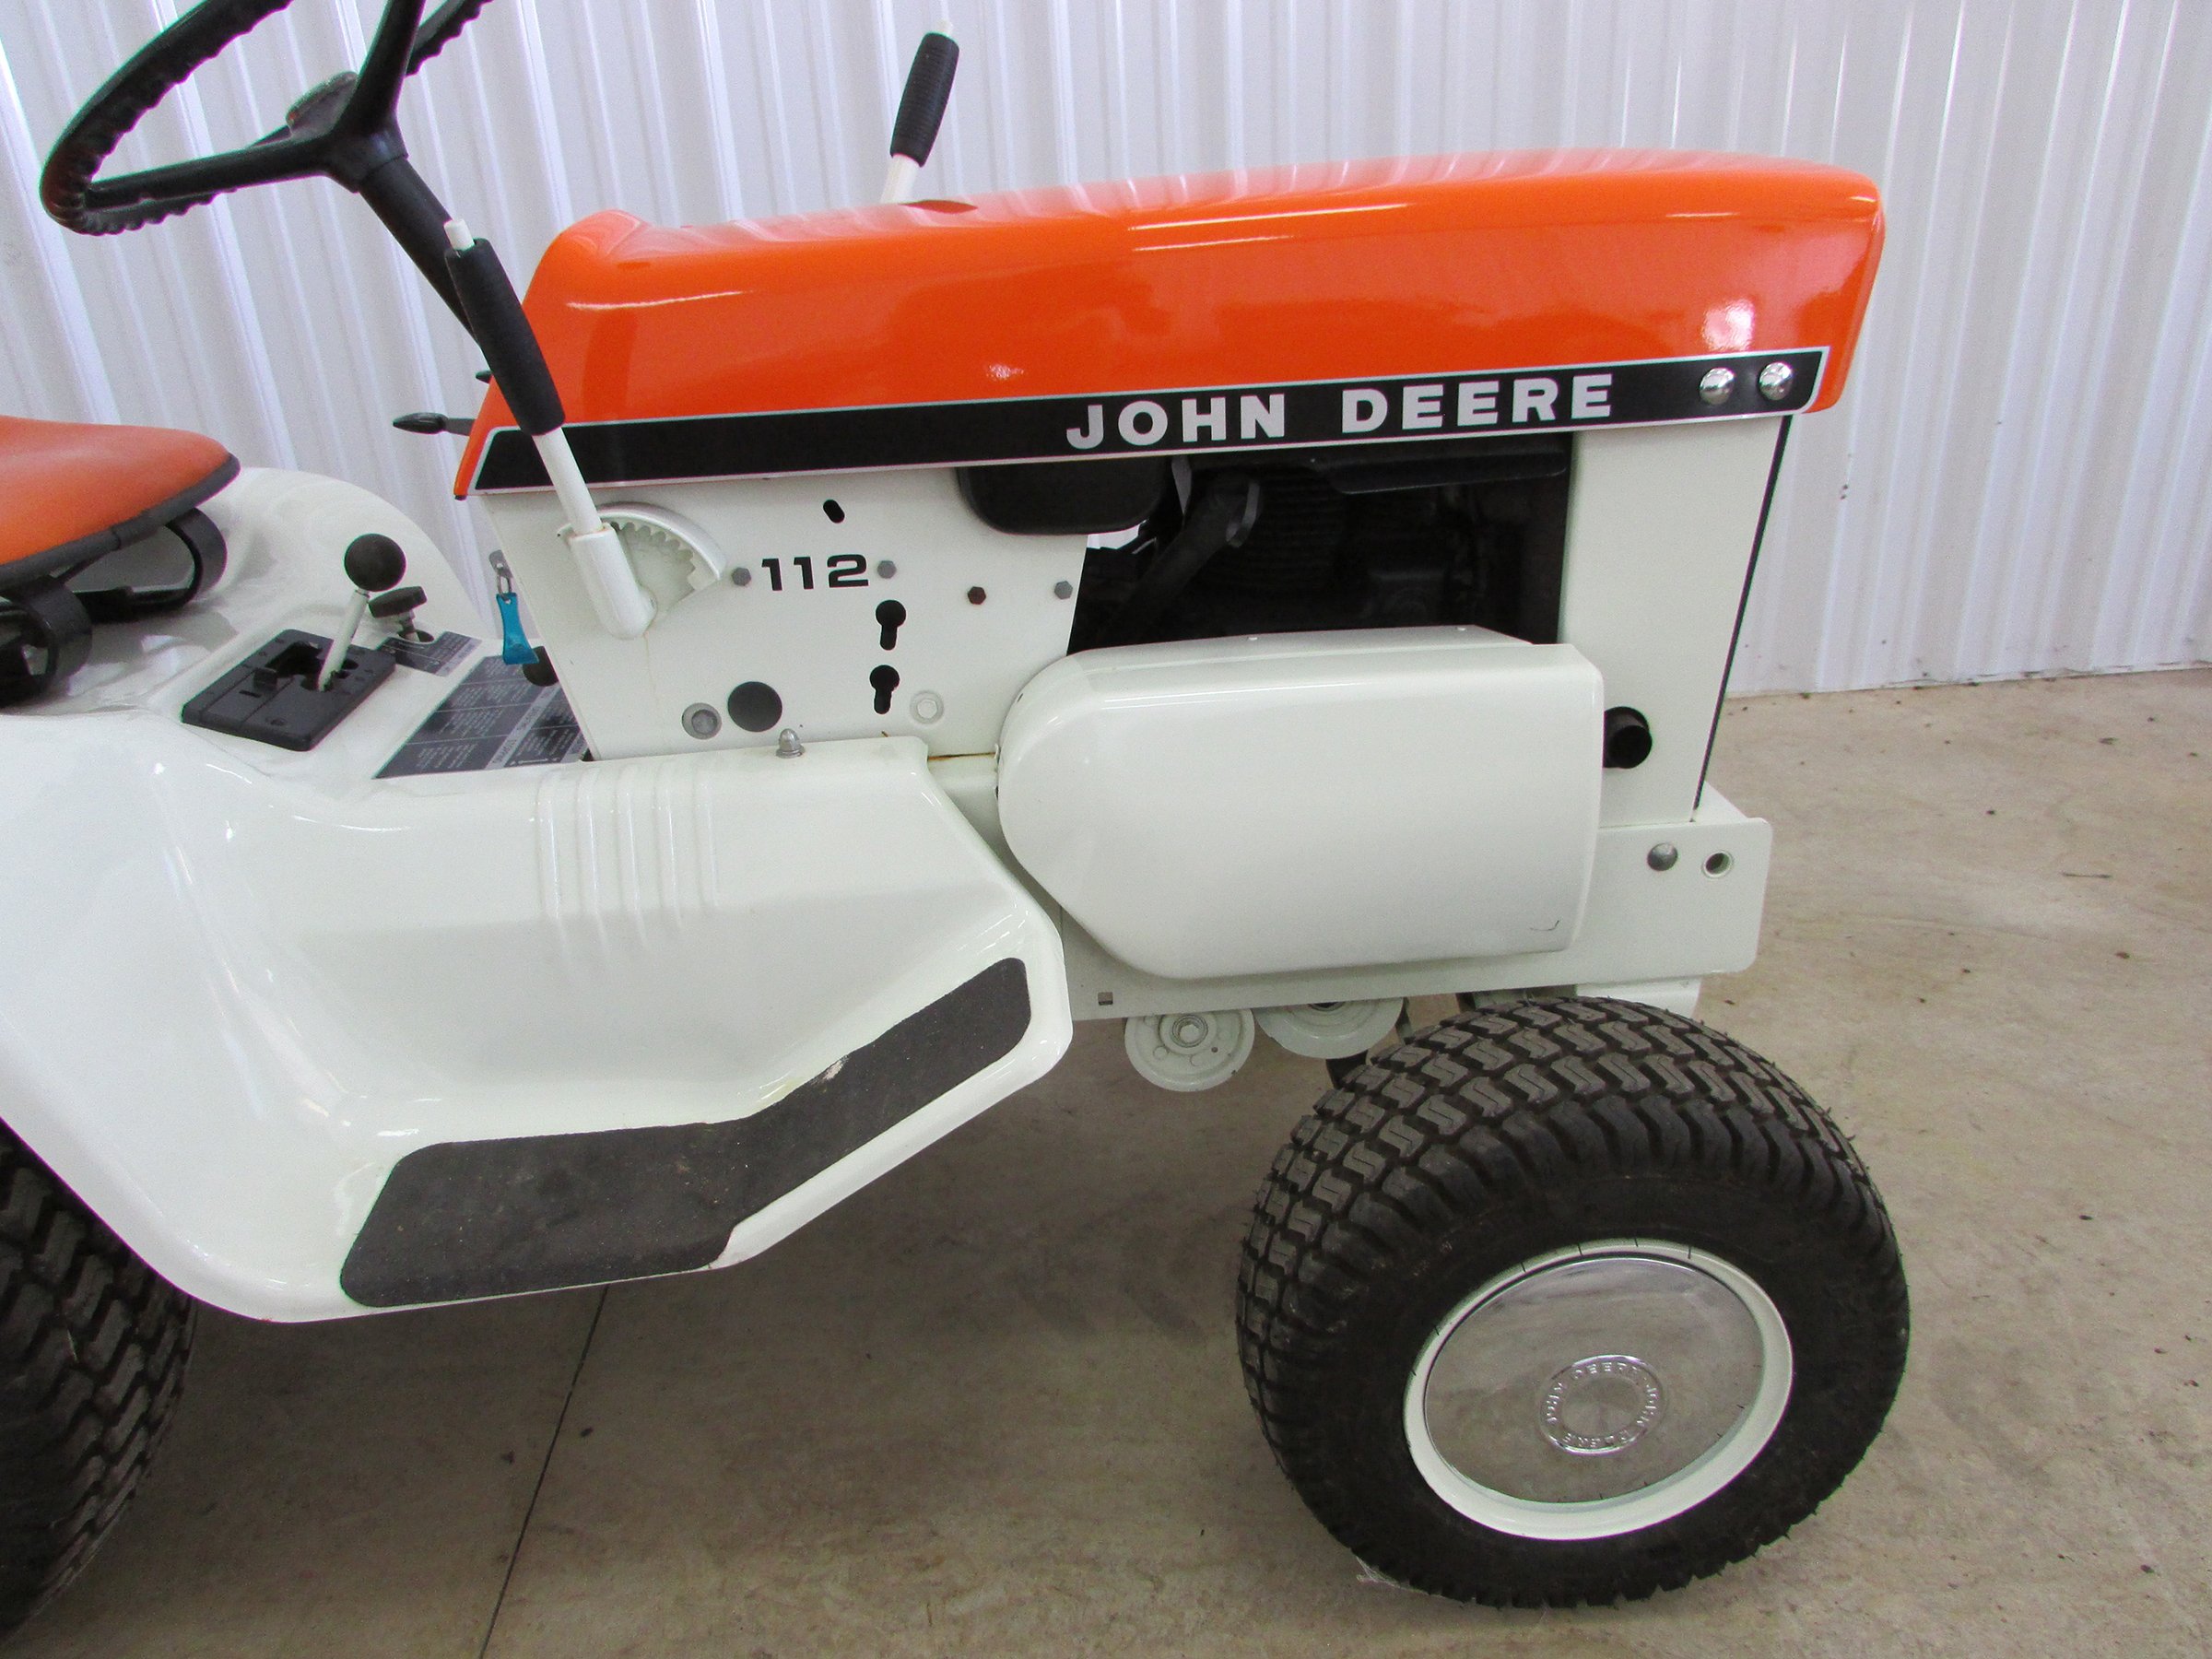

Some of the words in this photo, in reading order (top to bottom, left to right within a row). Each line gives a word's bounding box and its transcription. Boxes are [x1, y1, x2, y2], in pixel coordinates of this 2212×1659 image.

[1066, 394, 1285, 449] JOHN
[1342, 373, 1612, 433] DEERE
[761, 554, 869, 591] 112
